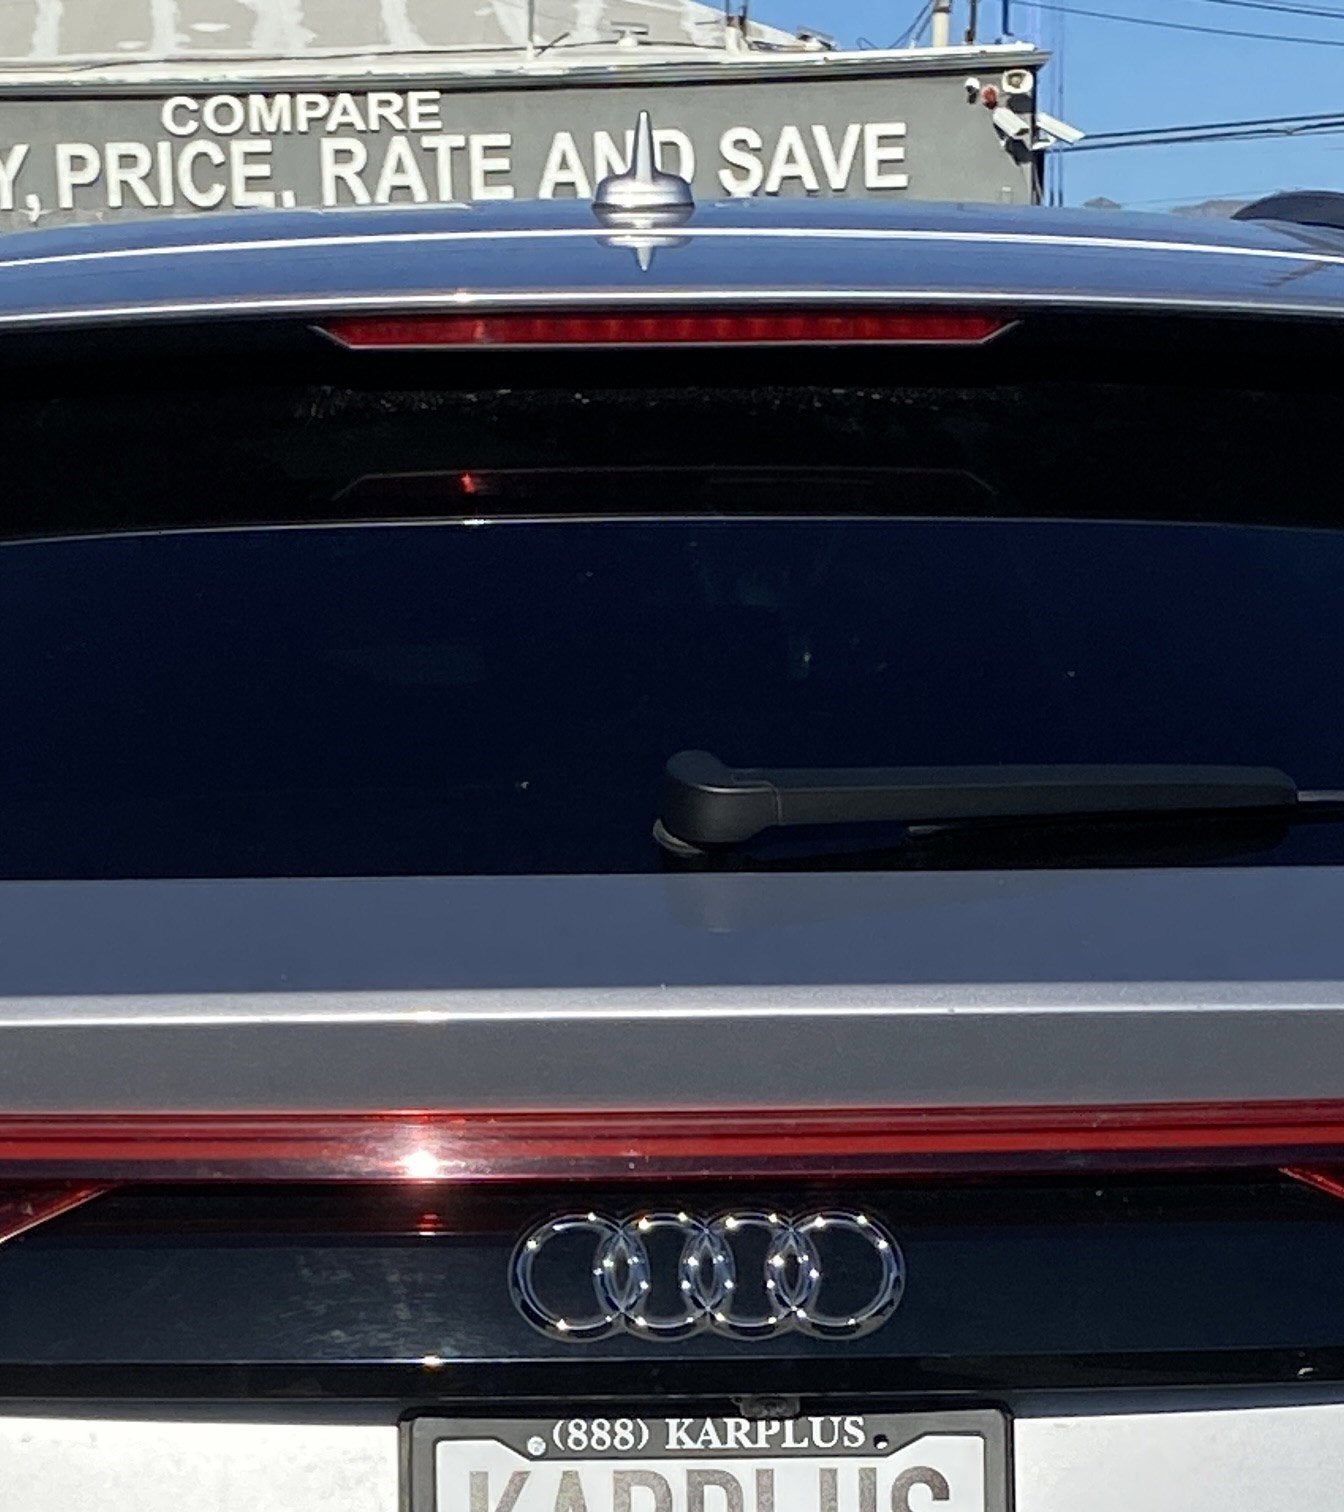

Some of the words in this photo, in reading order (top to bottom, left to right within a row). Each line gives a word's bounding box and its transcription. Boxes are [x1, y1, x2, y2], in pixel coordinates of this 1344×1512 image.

[161, 91, 443, 136] COMPARE
[319, 133, 514, 207] RATE
[718, 122, 909, 197] SAVE
[552, 1418, 650, 1452] (888)
[666, 1416, 867, 1450] KARPLUS
